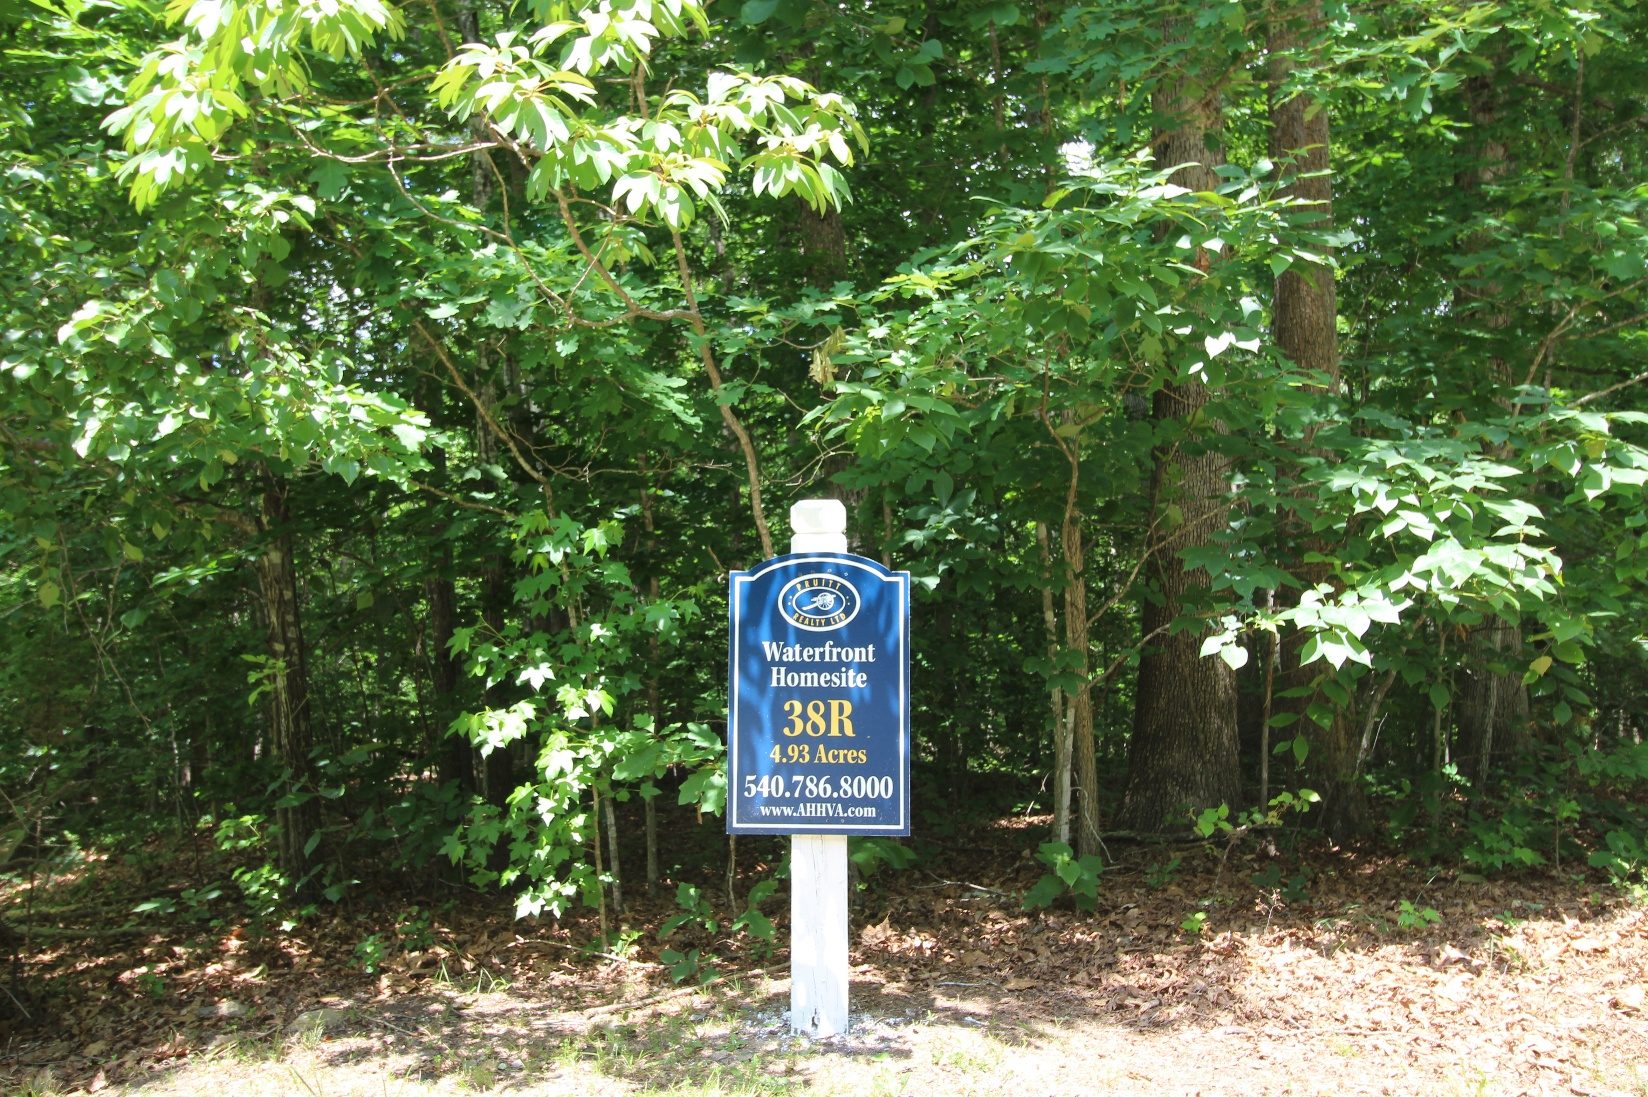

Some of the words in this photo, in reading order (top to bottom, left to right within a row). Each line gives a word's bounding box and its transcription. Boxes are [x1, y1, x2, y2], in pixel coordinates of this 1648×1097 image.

[795, 578, 841, 591] PRUITT
[792, 612, 826, 626] REALTY
[830, 612, 847, 625] LTD
[761, 640, 876, 663] Waterfront
[770, 666, 868, 688] Homesite
[782, 699, 856, 737] 38R
[769, 743, 810, 763] 4.93
[813, 743, 867, 764] Acres
[743, 774, 894, 799] 540.786.8000
[760, 802, 876, 817] www.AHHVA.com
